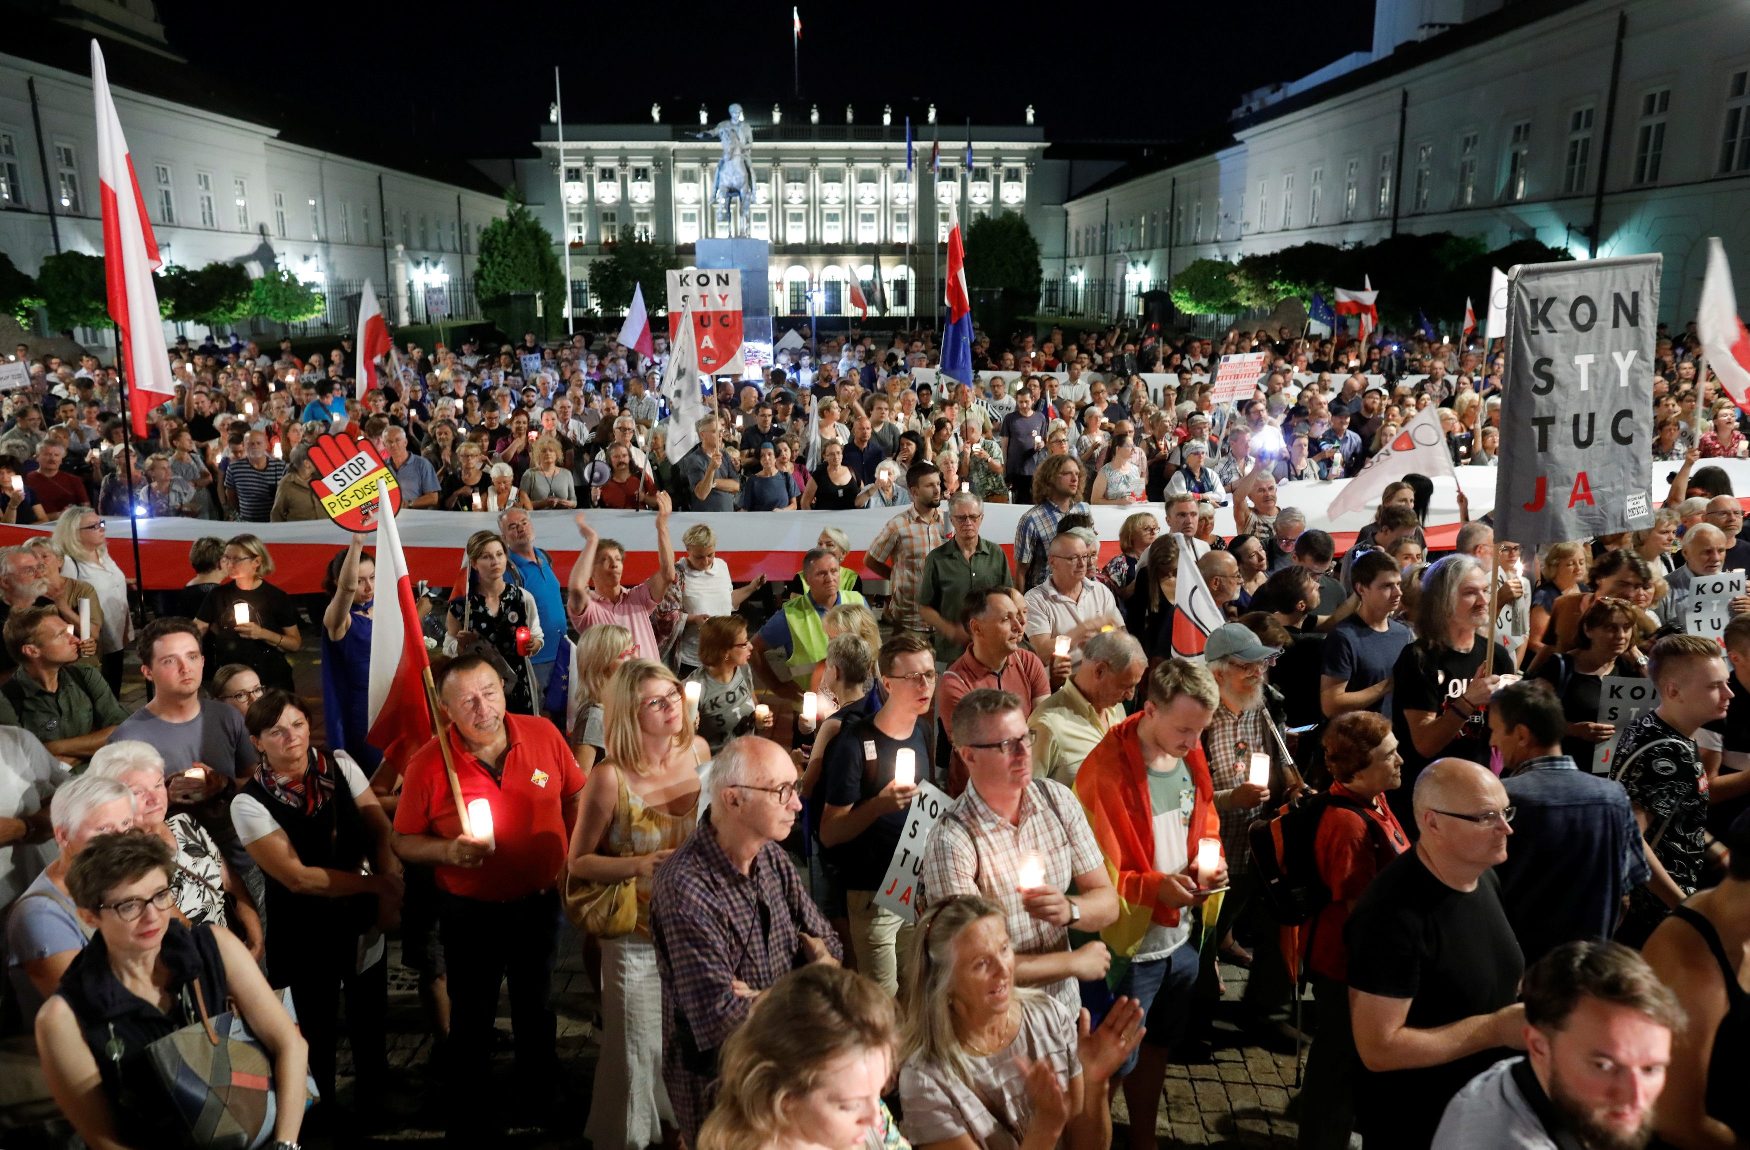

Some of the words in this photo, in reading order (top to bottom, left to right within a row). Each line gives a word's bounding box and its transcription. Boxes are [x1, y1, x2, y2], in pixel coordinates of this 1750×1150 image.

[679, 273, 730, 287] KON
[700, 314, 730, 328] UC
[1530, 291, 1640, 336] KON
[700, 335, 714, 349] A
[1531, 350, 1638, 396] STY
[1531, 409, 1634, 453] TUC
[332, 456, 368, 488] STOP
[327, 472, 396, 515] PiS-DISEE
[1523, 471, 1596, 513] JA
[1696, 580, 1741, 596] KON
[1496, 610, 1512, 630] UC
[1694, 600, 1721, 613] ST
[1694, 618, 1722, 631] TU
[1608, 707, 1654, 721] ST
[917, 792, 947, 820] KO
[901, 848, 924, 876] TU
[886, 878, 913, 906] JA
